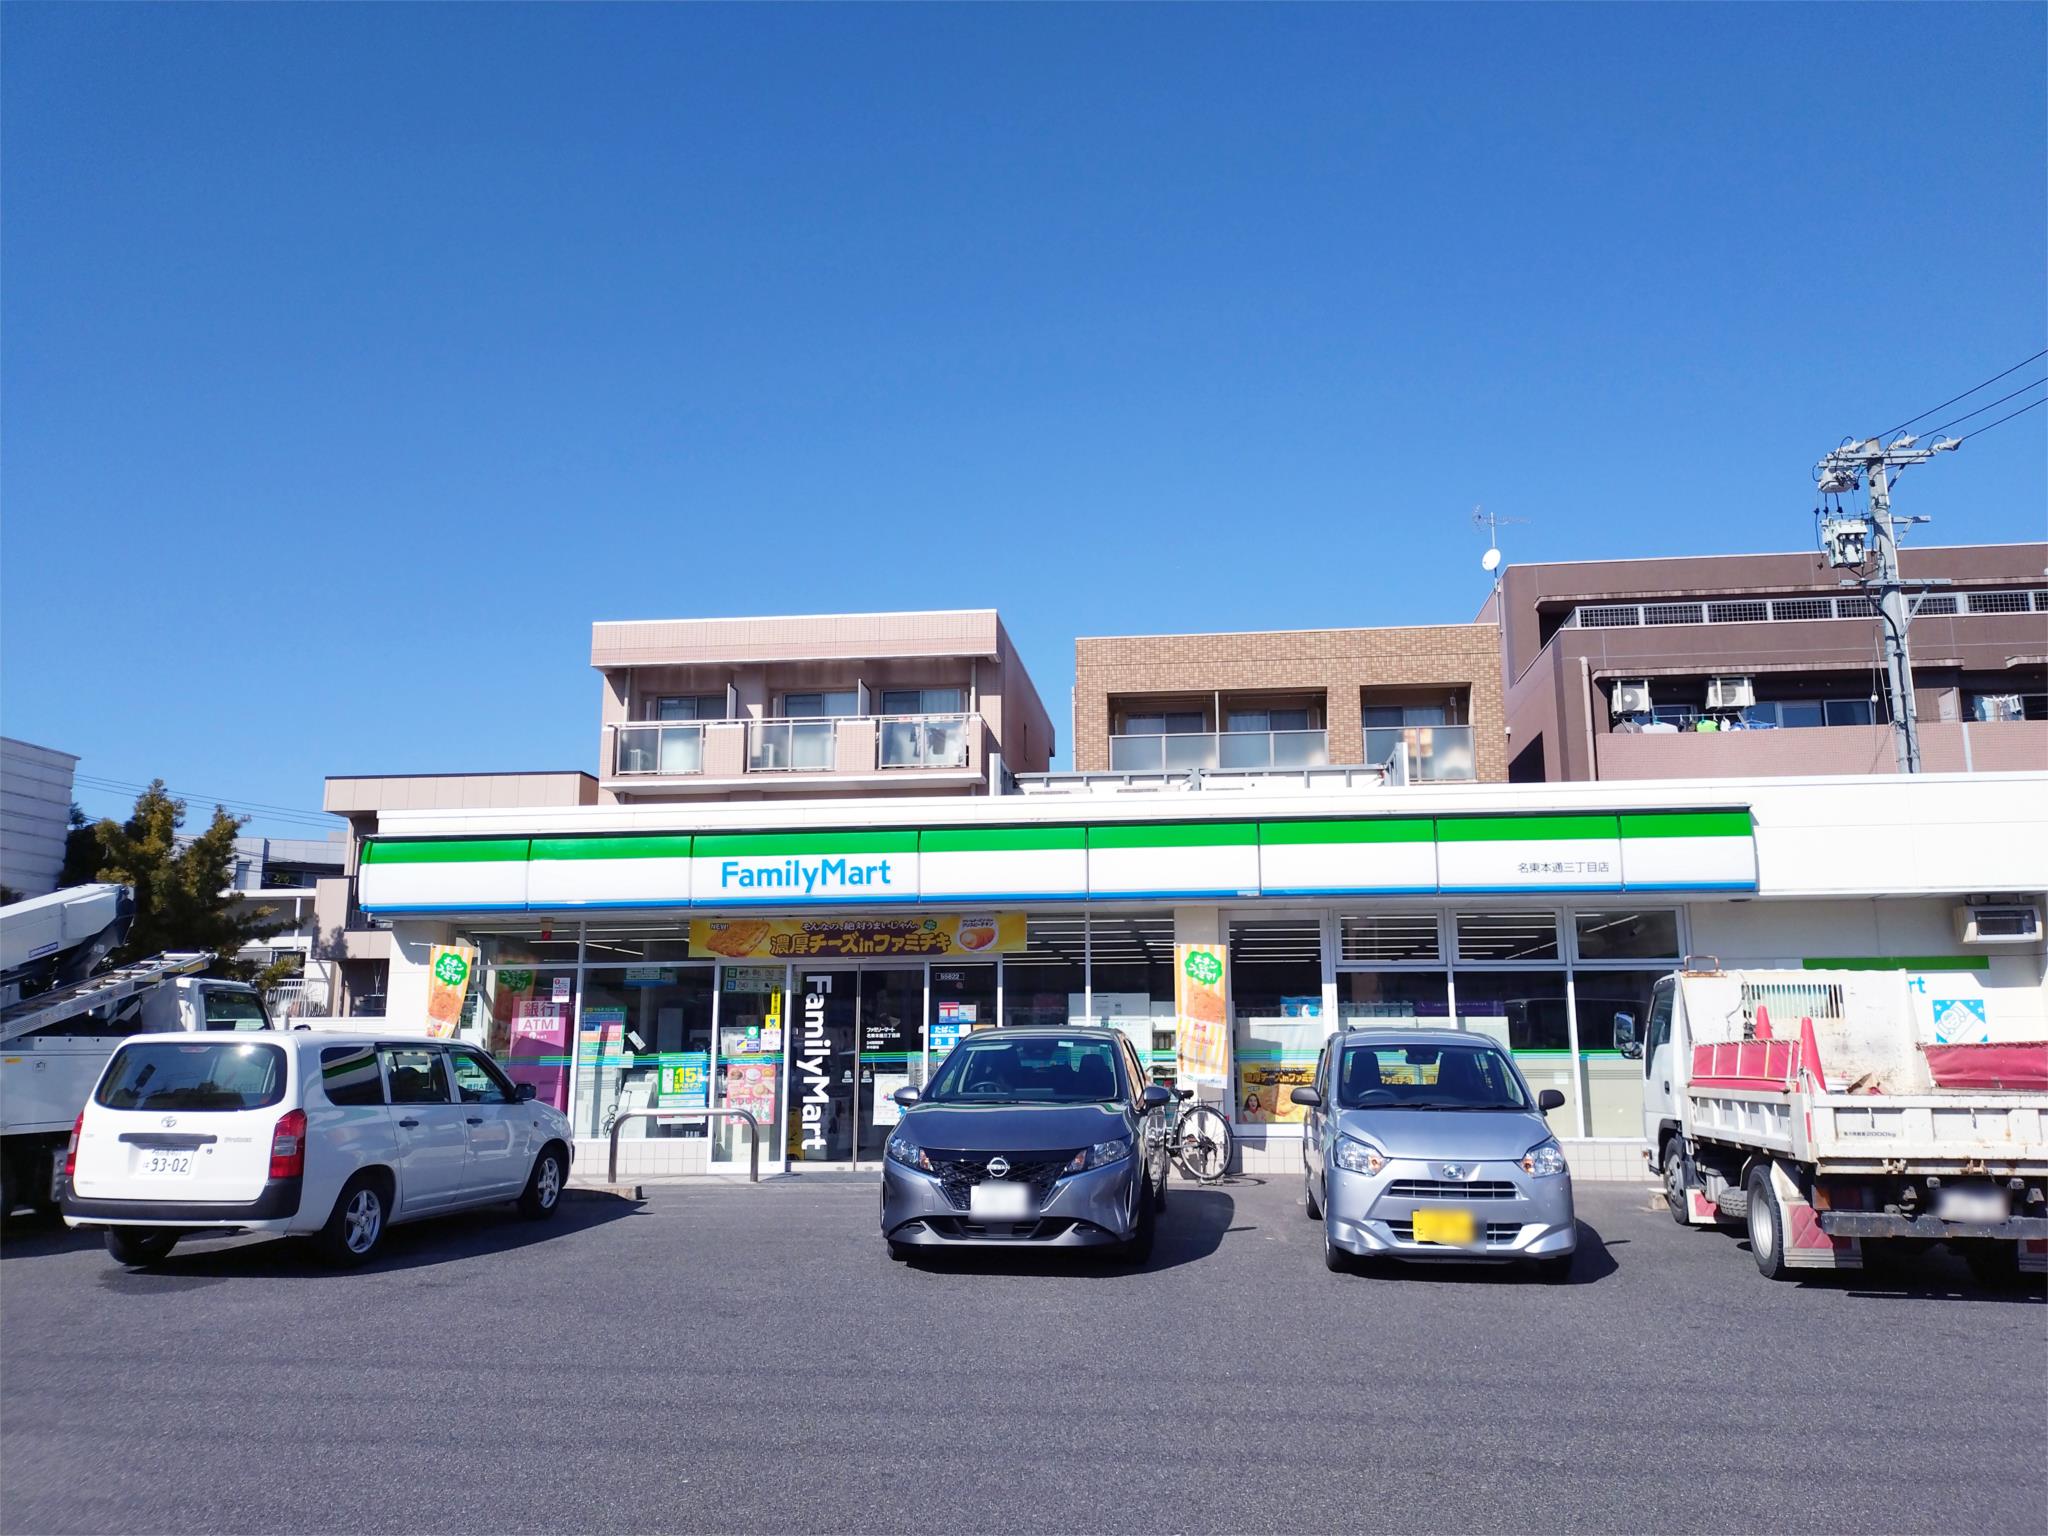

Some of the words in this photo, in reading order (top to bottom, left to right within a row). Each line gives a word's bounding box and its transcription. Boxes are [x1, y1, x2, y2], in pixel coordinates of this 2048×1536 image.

[1518, 862, 1609, 873] 名東本通三丁目店
[722, 859, 891, 893] FamilyMart
[802, 920, 920, 931] そんなの、絶対うまいじゃん。
[771, 932, 951, 954] 濃厚チーズinファミチキ
[524, 1003, 555, 1017] 銀行
[523, 1019, 554, 1030] ATM
[796, 975, 832, 1150] FamilyMart
[676, 1067, 697, 1083] 15
[151, 1158, 189, 1172] 93-02
